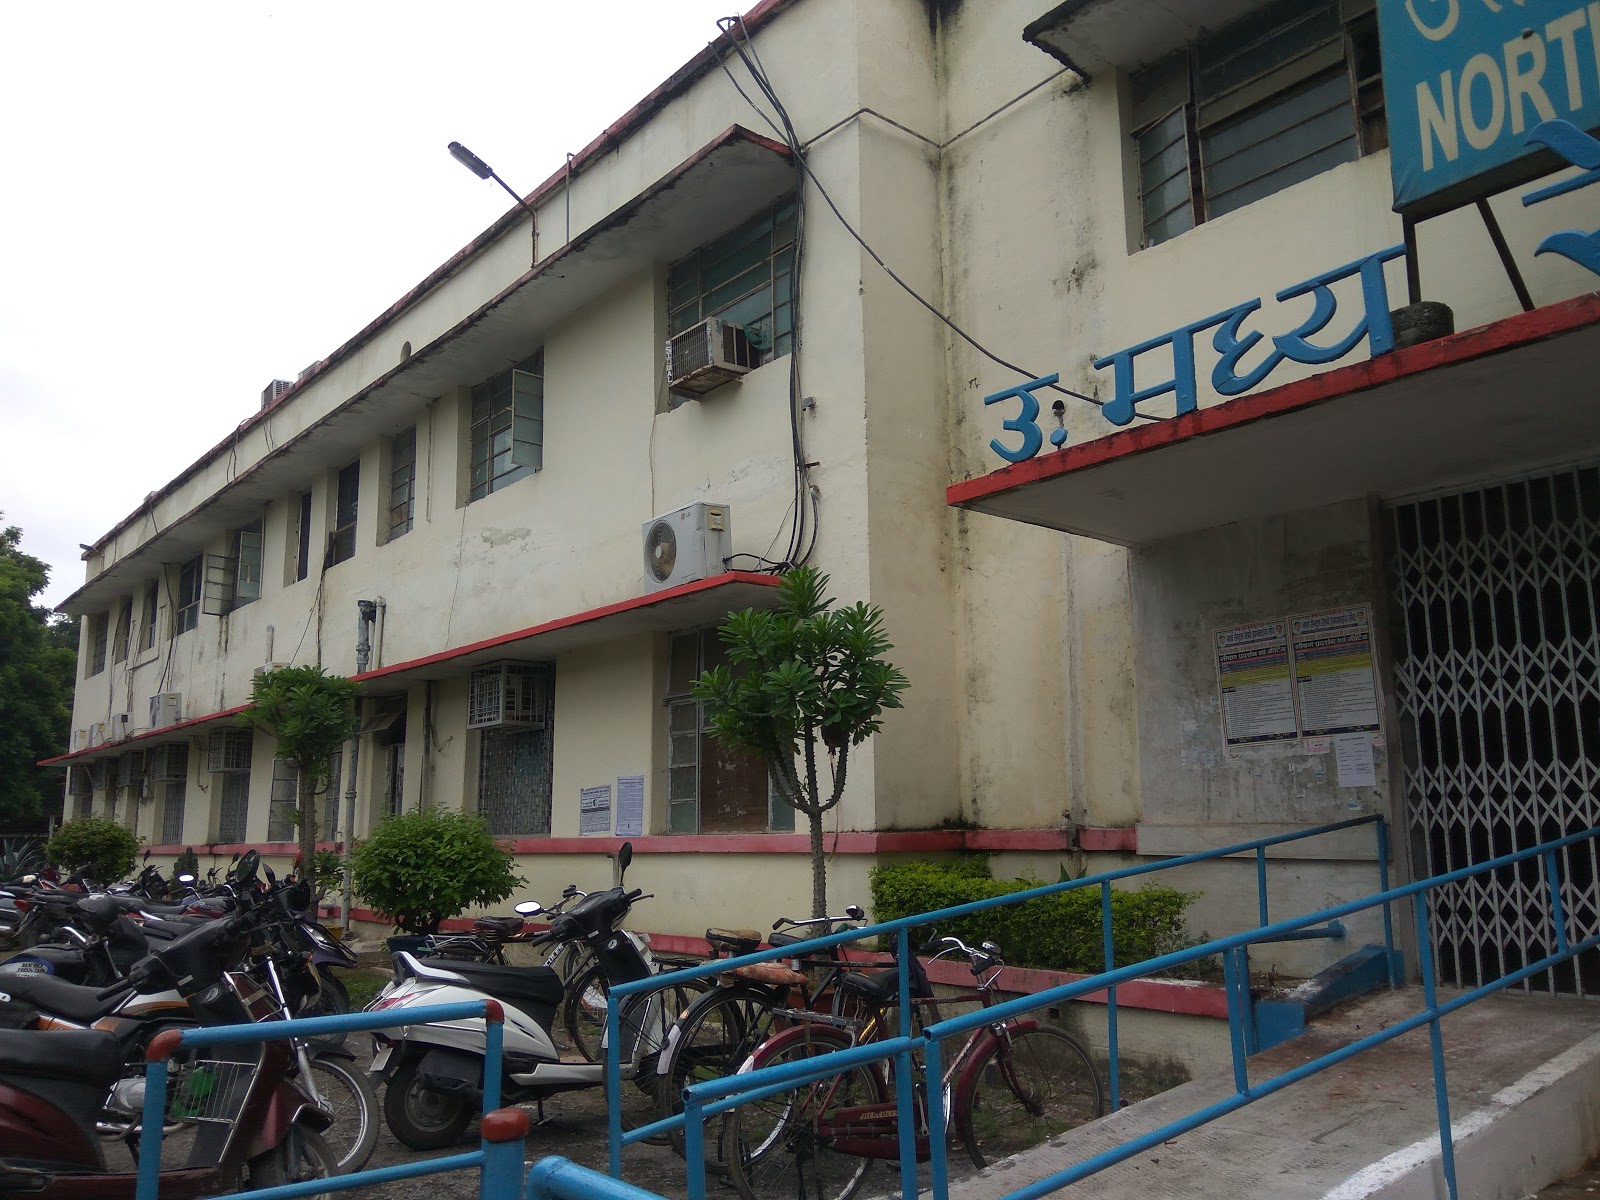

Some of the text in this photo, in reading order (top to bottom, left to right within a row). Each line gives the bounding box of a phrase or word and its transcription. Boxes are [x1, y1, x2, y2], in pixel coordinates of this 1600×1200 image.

[1415, 2, 1600, 172] NORT
[1093, 242, 1407, 426] मध्य
[543, 942, 565, 967] CULES
